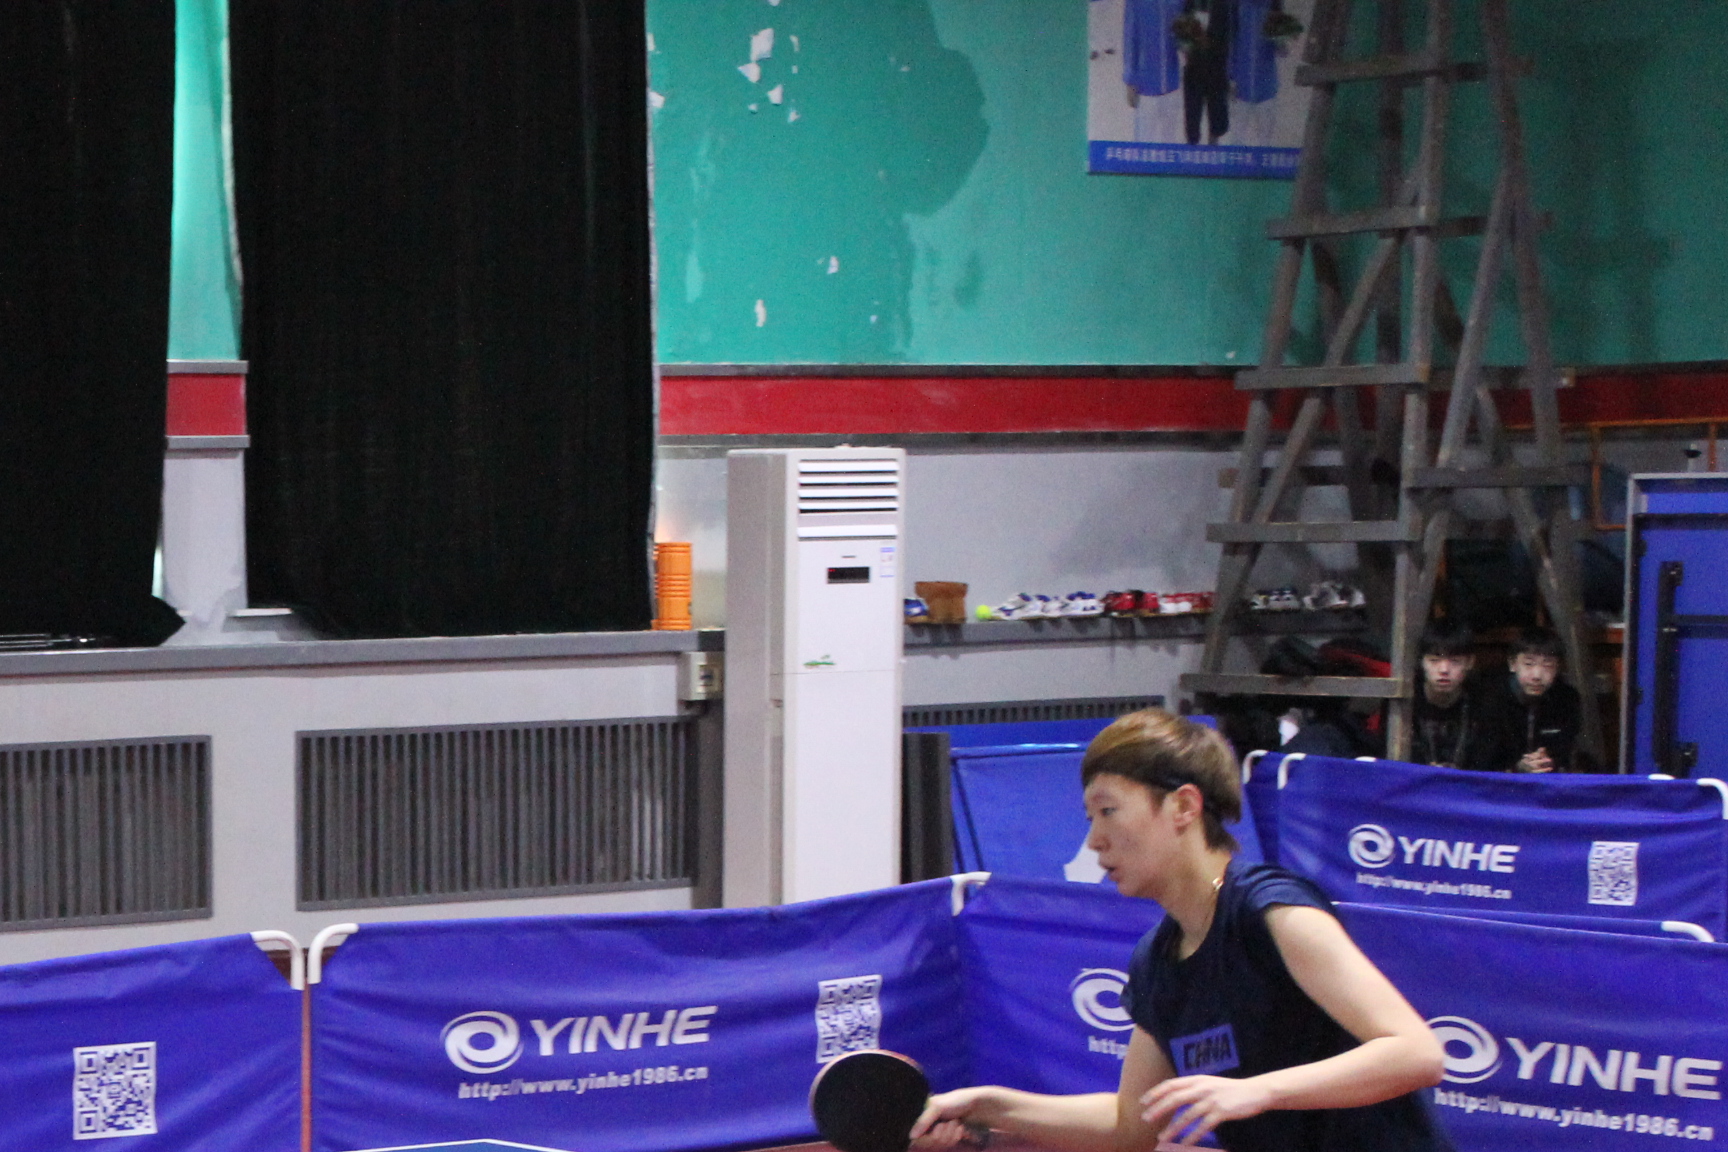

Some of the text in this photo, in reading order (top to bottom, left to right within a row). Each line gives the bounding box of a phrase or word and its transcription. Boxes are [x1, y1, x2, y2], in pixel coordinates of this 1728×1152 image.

[1398, 836, 1521, 873] YINHE
[530, 1005, 718, 1056] YINHE
[458, 1065, 708, 1100] http://www.yinhe1986.cn
[1505, 1037, 1723, 1100] YINHE
[1434, 1087, 1713, 1141] http://www.yinhe1986.cn
